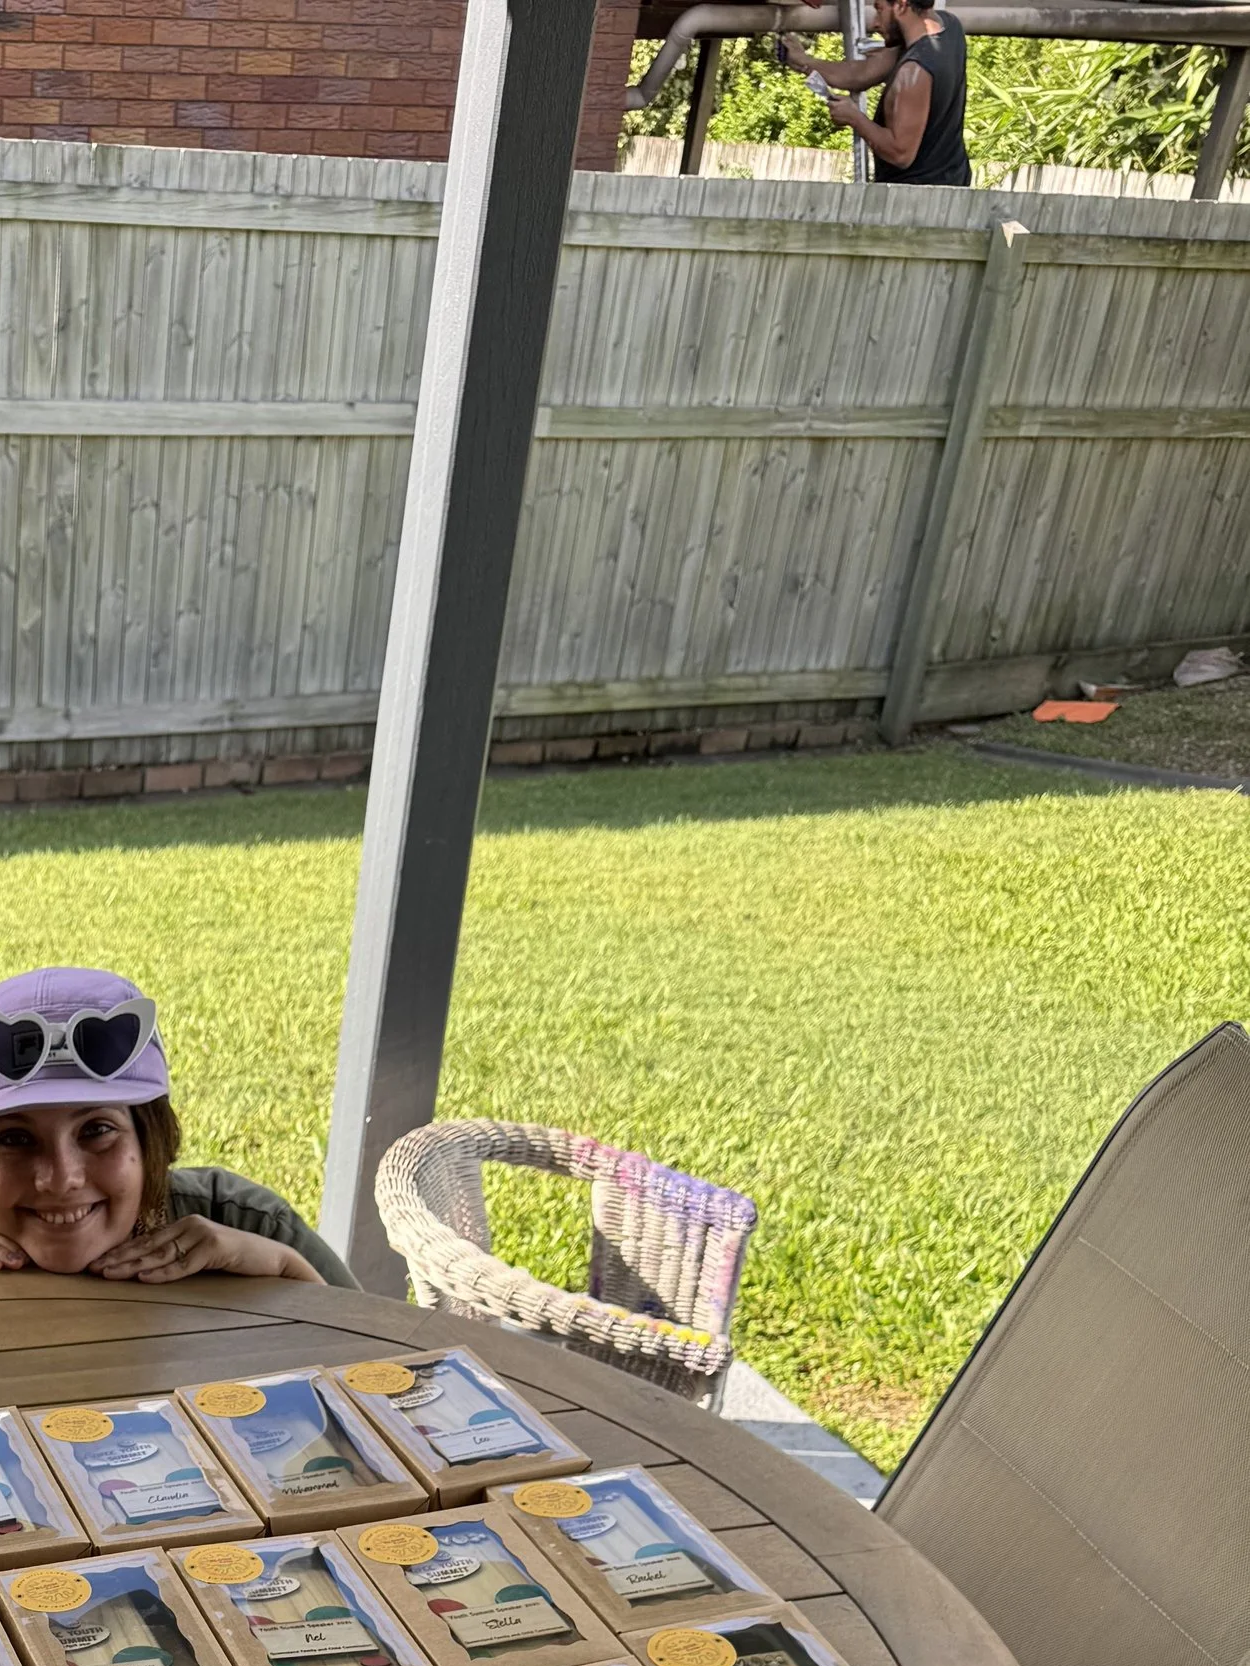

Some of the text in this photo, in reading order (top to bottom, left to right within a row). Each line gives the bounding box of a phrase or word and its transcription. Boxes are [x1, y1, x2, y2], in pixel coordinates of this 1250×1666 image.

[426, 1567, 469, 1579] SUMMIT
[626, 1571, 667, 1585] Rachel
[67, 1627, 103, 1637] YOUTH
